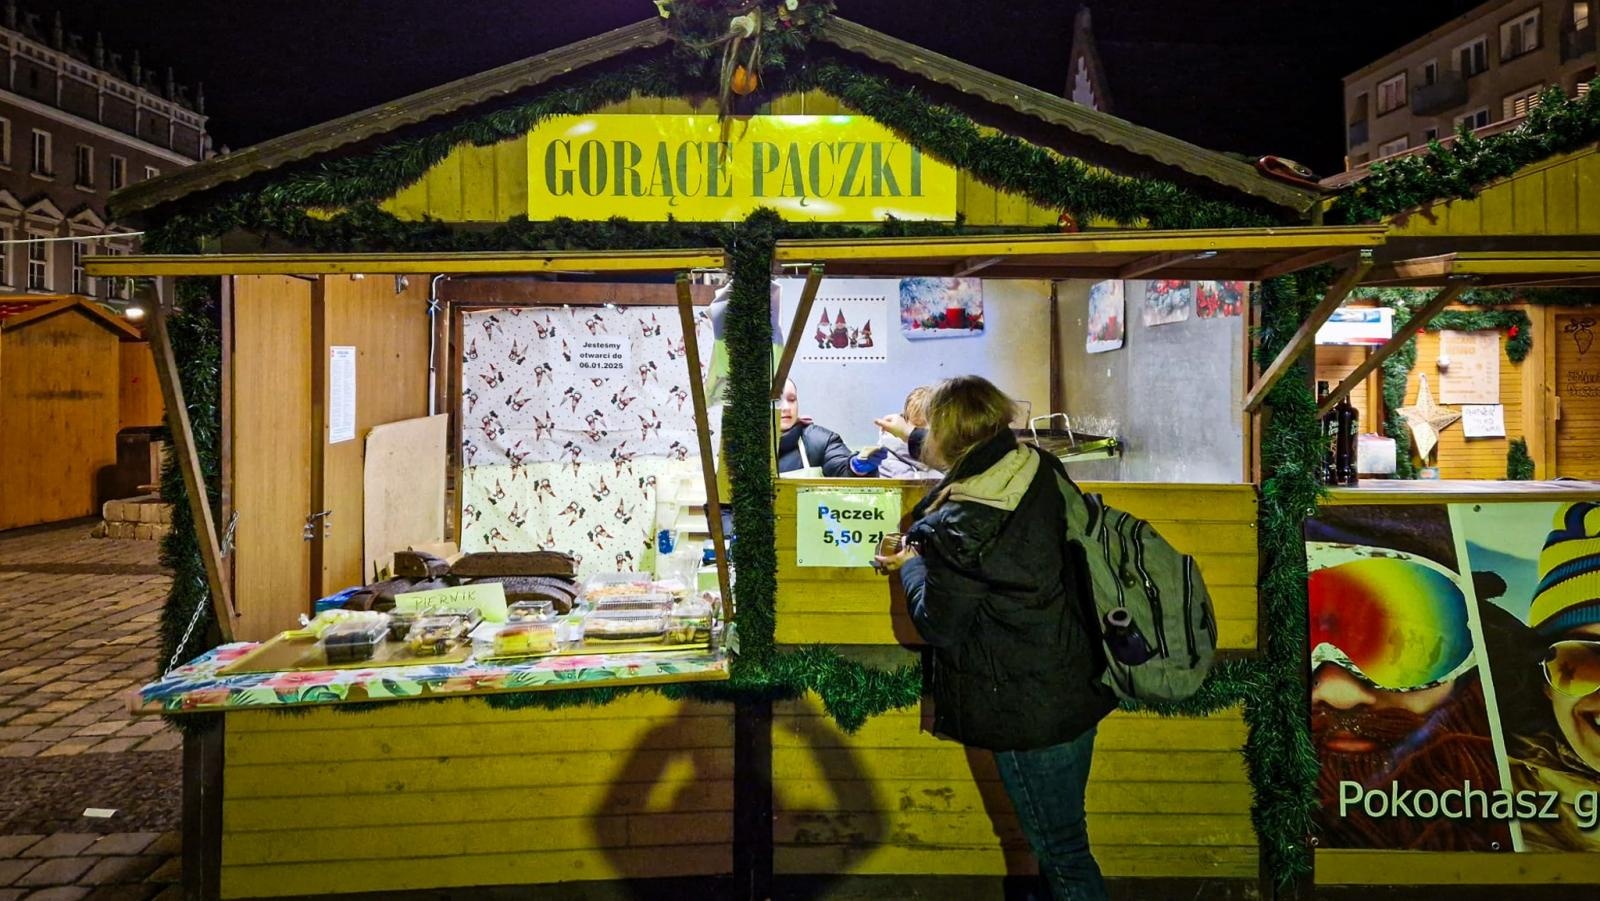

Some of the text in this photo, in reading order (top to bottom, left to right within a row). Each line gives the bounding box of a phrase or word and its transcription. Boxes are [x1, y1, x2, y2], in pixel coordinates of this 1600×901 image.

[544, 139, 926, 206] GORĄCE PĄCZKI
[582, 341, 621, 350] Jesteśmy
[817, 506, 884, 522] Pączek
[823, 530, 884, 546] 5,50 zł
[1339, 780, 1559, 818] Pokochasz
